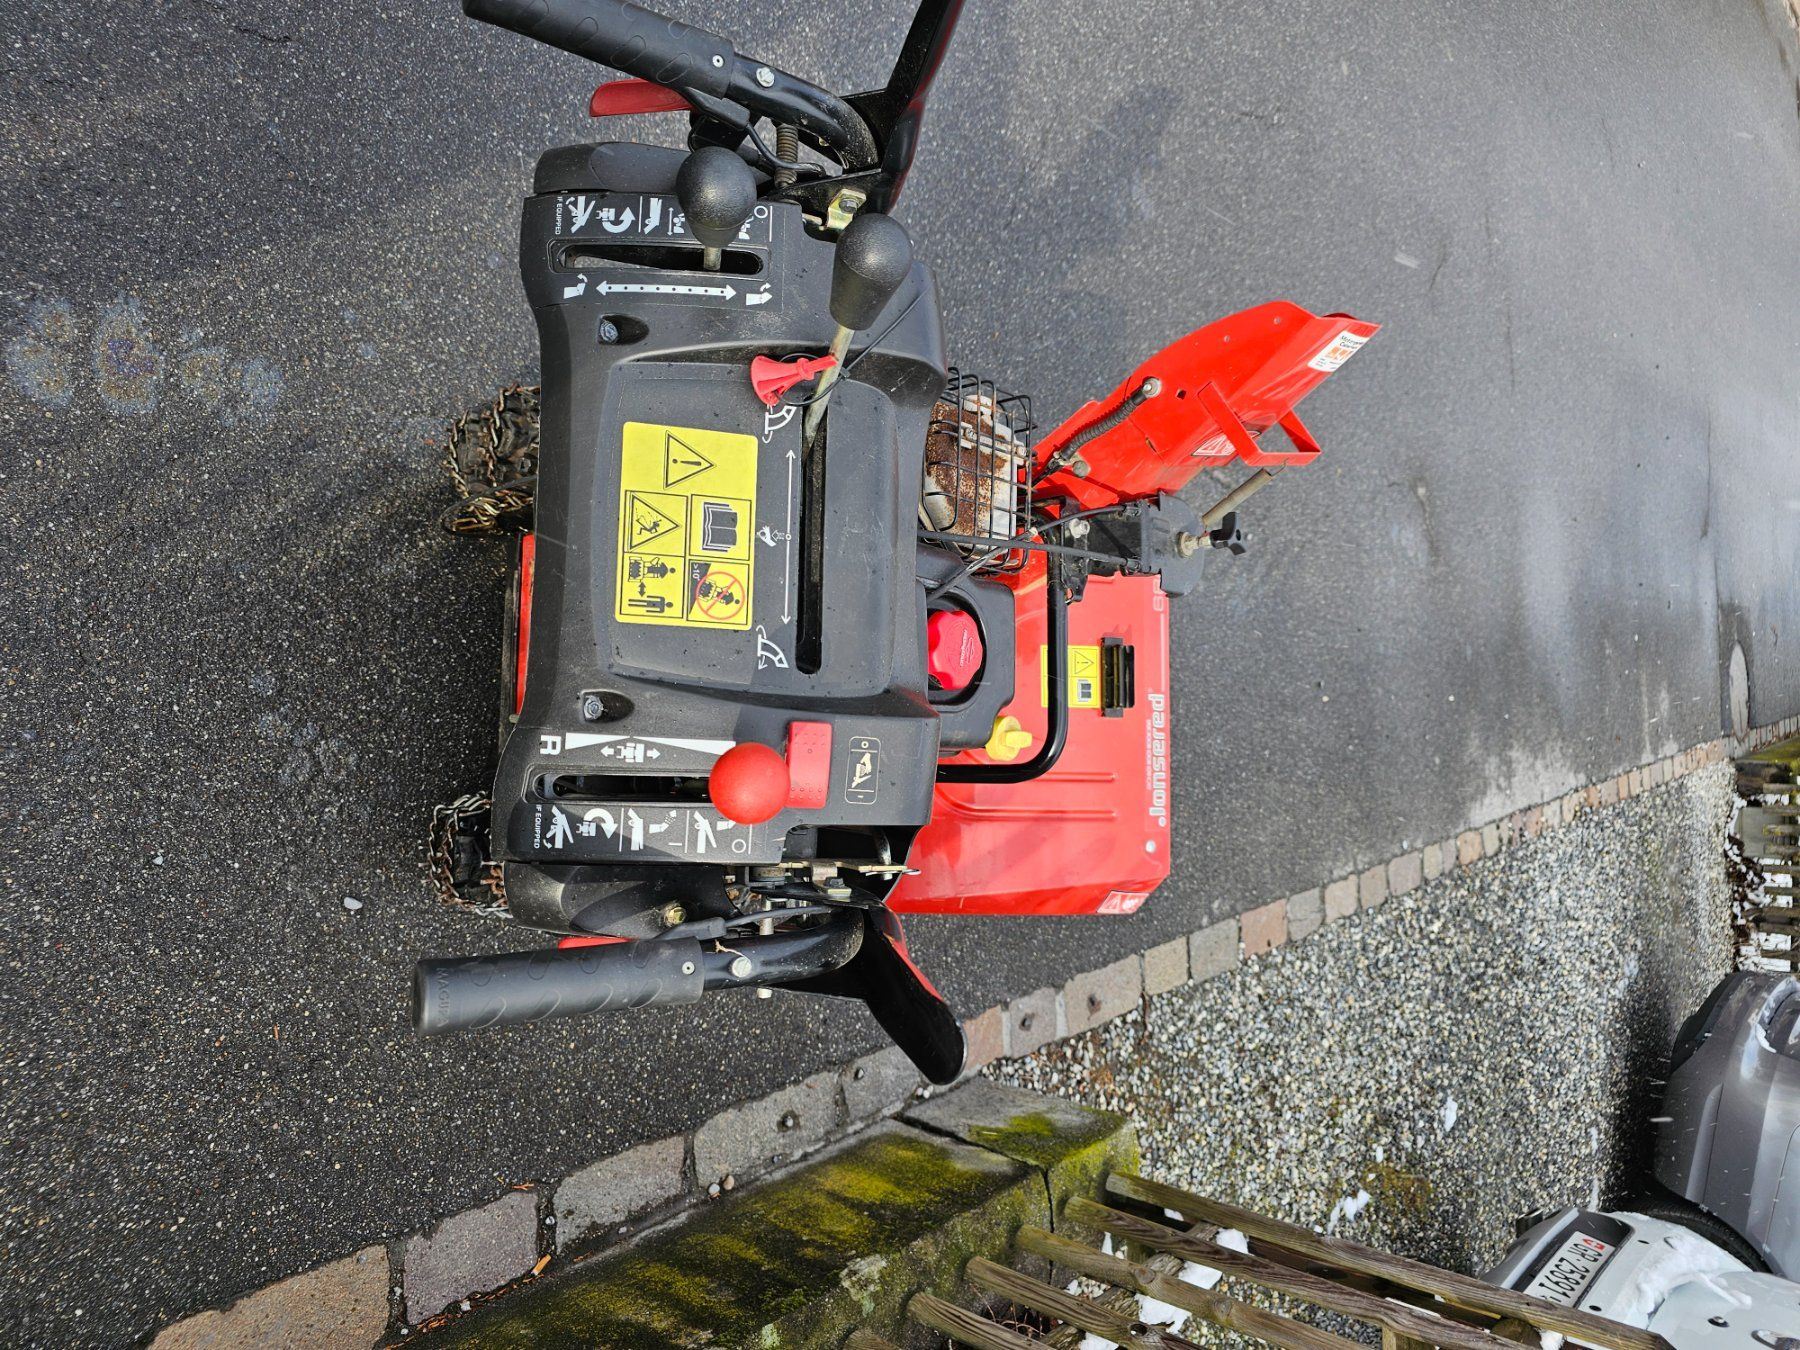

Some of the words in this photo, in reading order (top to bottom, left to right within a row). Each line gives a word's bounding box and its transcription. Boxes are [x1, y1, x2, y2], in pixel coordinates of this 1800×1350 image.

[554, 203, 563, 235] EQUIPPED
[540, 734, 561, 756] R
[1148, 694, 1166, 827] Jonsered
[535, 804, 542, 812] IF
[533, 812, 542, 849] EQUIPPED
[436, 967, 449, 1028] MAGURA
